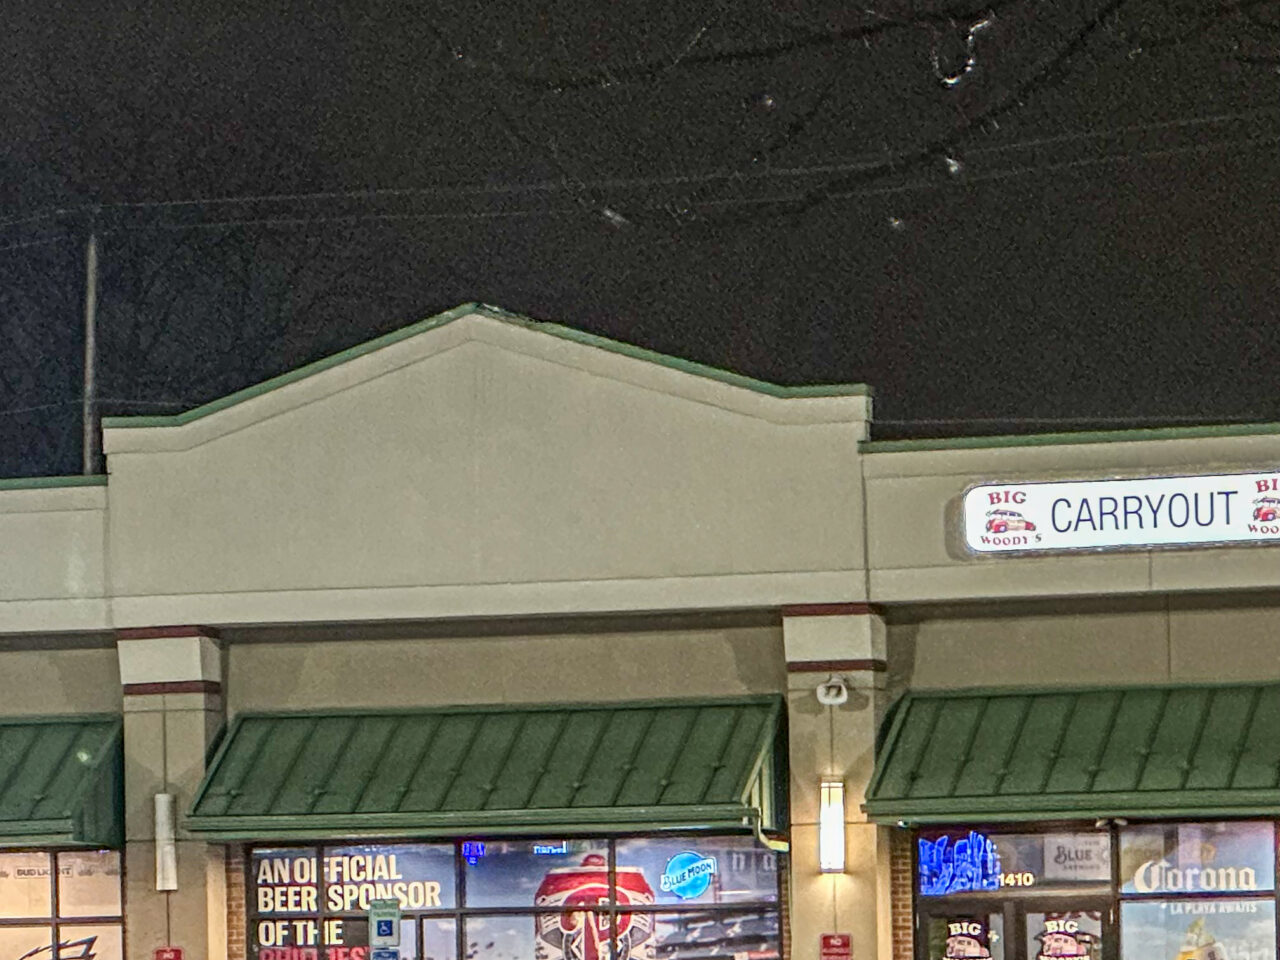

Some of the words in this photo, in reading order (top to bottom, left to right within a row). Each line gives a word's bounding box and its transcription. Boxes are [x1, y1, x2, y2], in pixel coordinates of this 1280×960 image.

[1256, 478, 1280, 493] BI
[988, 490, 1026, 505] BIG
[1051, 491, 1238, 533] CARRYOUT
[257, 858, 290, 884] AN
[293, 855, 402, 883] OFFICIAL
[688, 861, 712, 877] MOON
[1134, 859, 1257, 892] Corona
[999, 873, 1034, 887] 1410
[258, 886, 318, 912] BEER
[328, 881, 441, 911] SPONSOR
[1170, 903, 1183, 915] LA
[1185, 903, 1215, 914] PLAYA
[1219, 902, 1257, 913] AWAITS
[258, 920, 288, 946] OF
[292, 920, 343, 946] THE
[948, 922, 982, 936] BIG
[1044, 920, 1079, 933] BIG
